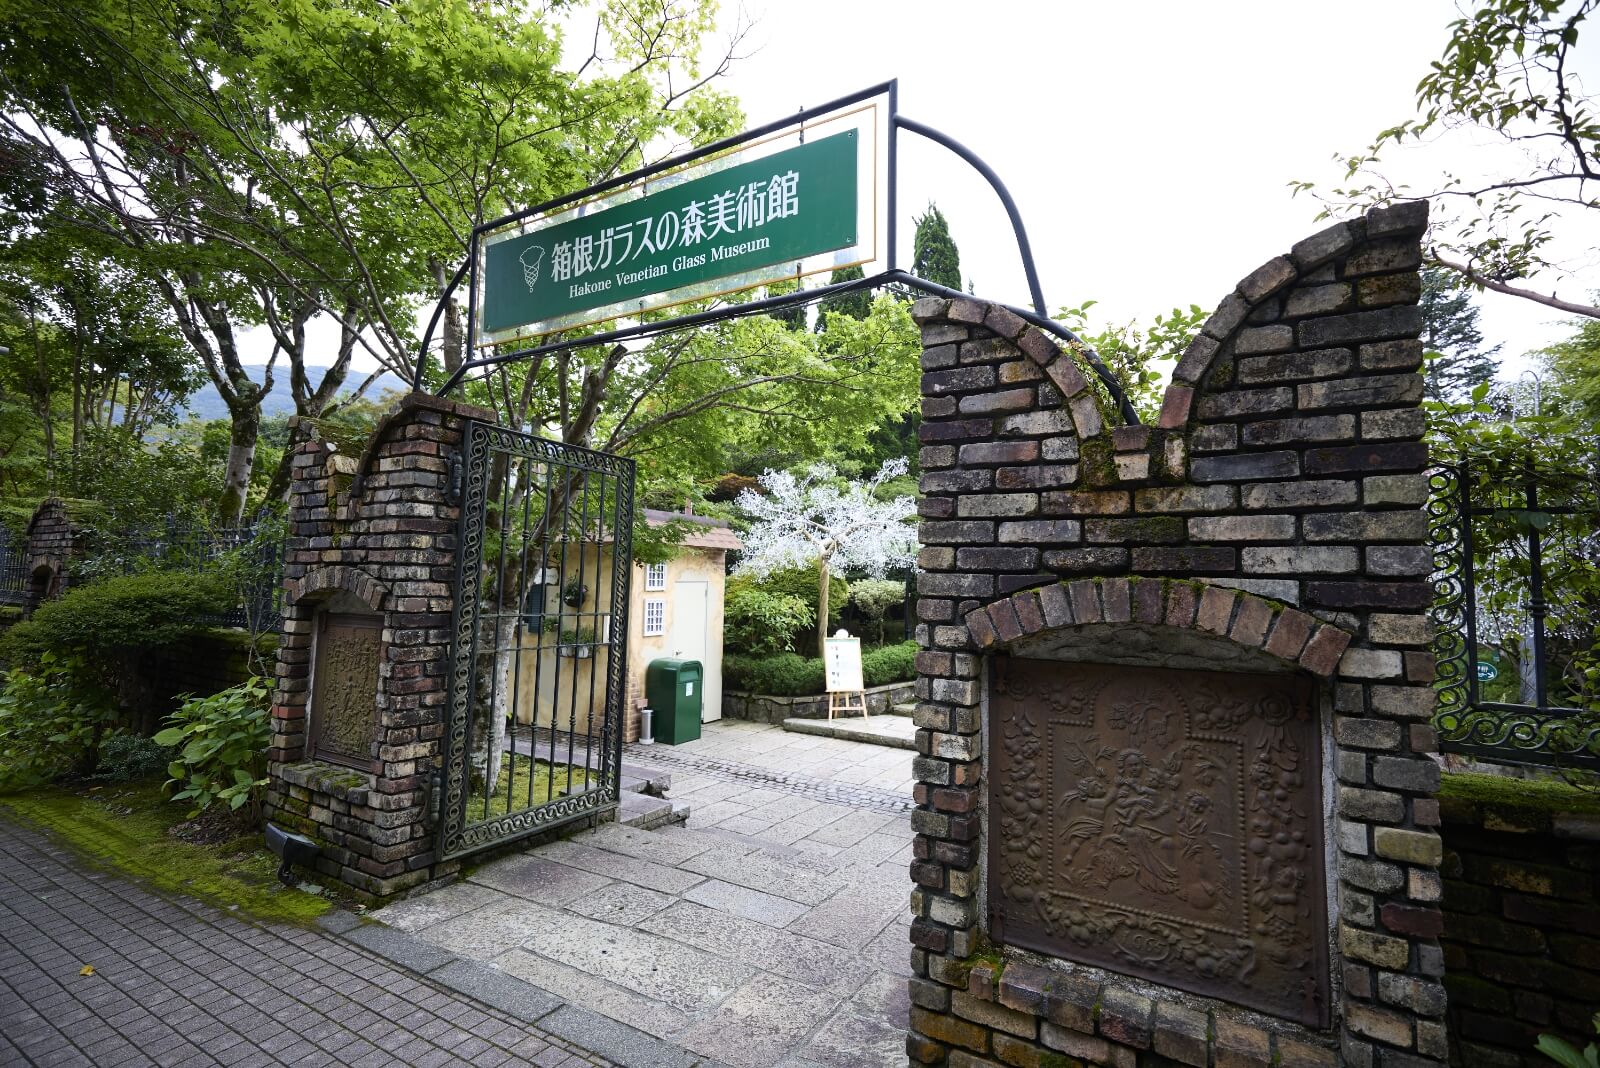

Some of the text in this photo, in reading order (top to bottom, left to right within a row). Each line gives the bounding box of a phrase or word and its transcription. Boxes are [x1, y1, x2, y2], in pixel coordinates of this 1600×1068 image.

[551, 170, 800, 282] 箱根ガラスの森美術館
[569, 236, 770, 299] Hakone Venetian Glass Museum
